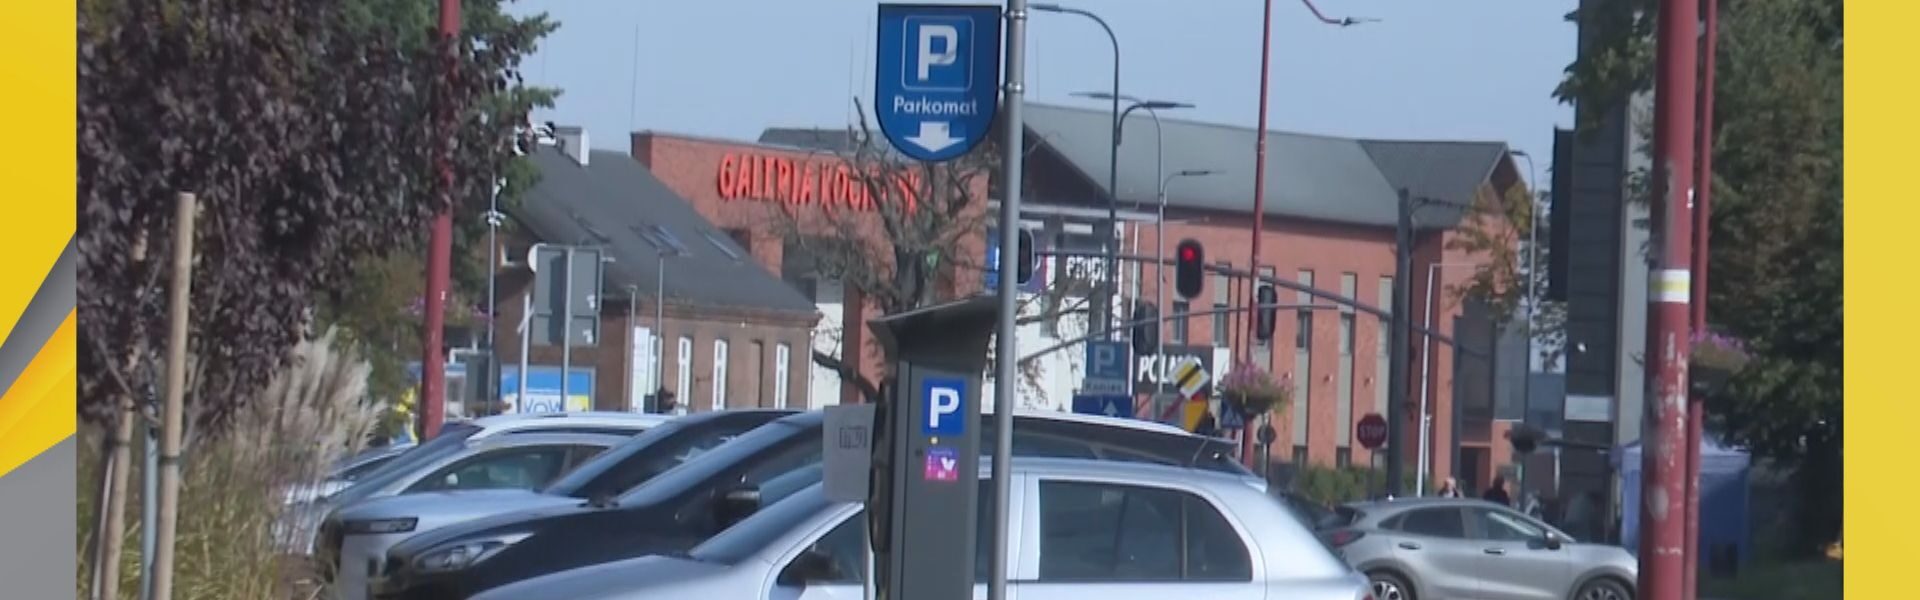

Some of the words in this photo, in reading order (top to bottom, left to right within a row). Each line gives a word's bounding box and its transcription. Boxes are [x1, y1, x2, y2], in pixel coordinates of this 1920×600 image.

[918, 25, 957, 81] P
[894, 95, 978, 115] Parkomat
[719, 152, 813, 205] GALERIA
[1095, 345, 1115, 374] P
[929, 387, 960, 428] P
[1359, 424, 1385, 438] STOP
